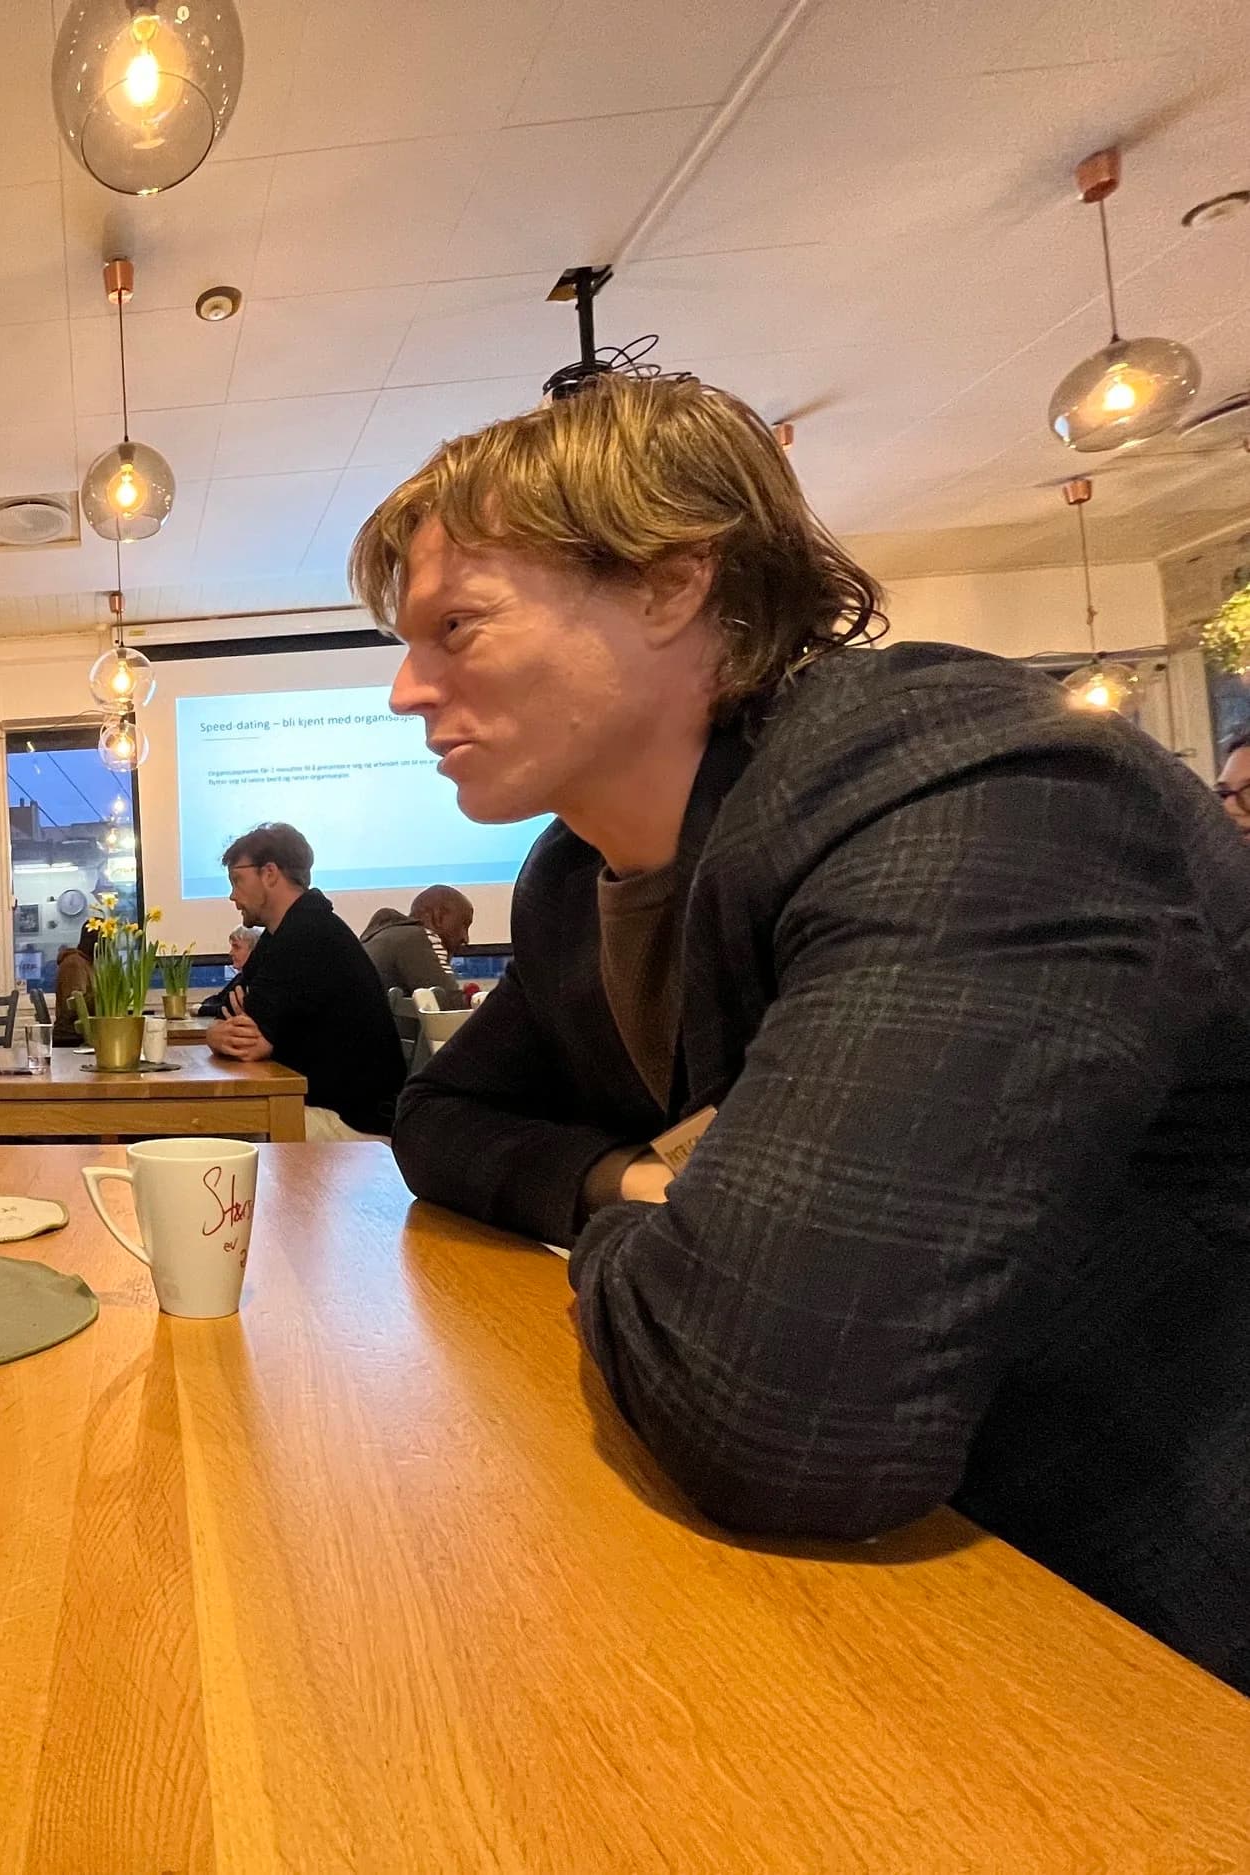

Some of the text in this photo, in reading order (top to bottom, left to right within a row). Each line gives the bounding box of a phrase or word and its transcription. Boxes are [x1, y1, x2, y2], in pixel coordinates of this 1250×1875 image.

[200, 722, 232, 733] Speed
[236, 720, 270, 731] dating
[282, 718, 295, 728] bli
[298, 716, 324, 728] kjent
[328, 715, 351, 725] med
